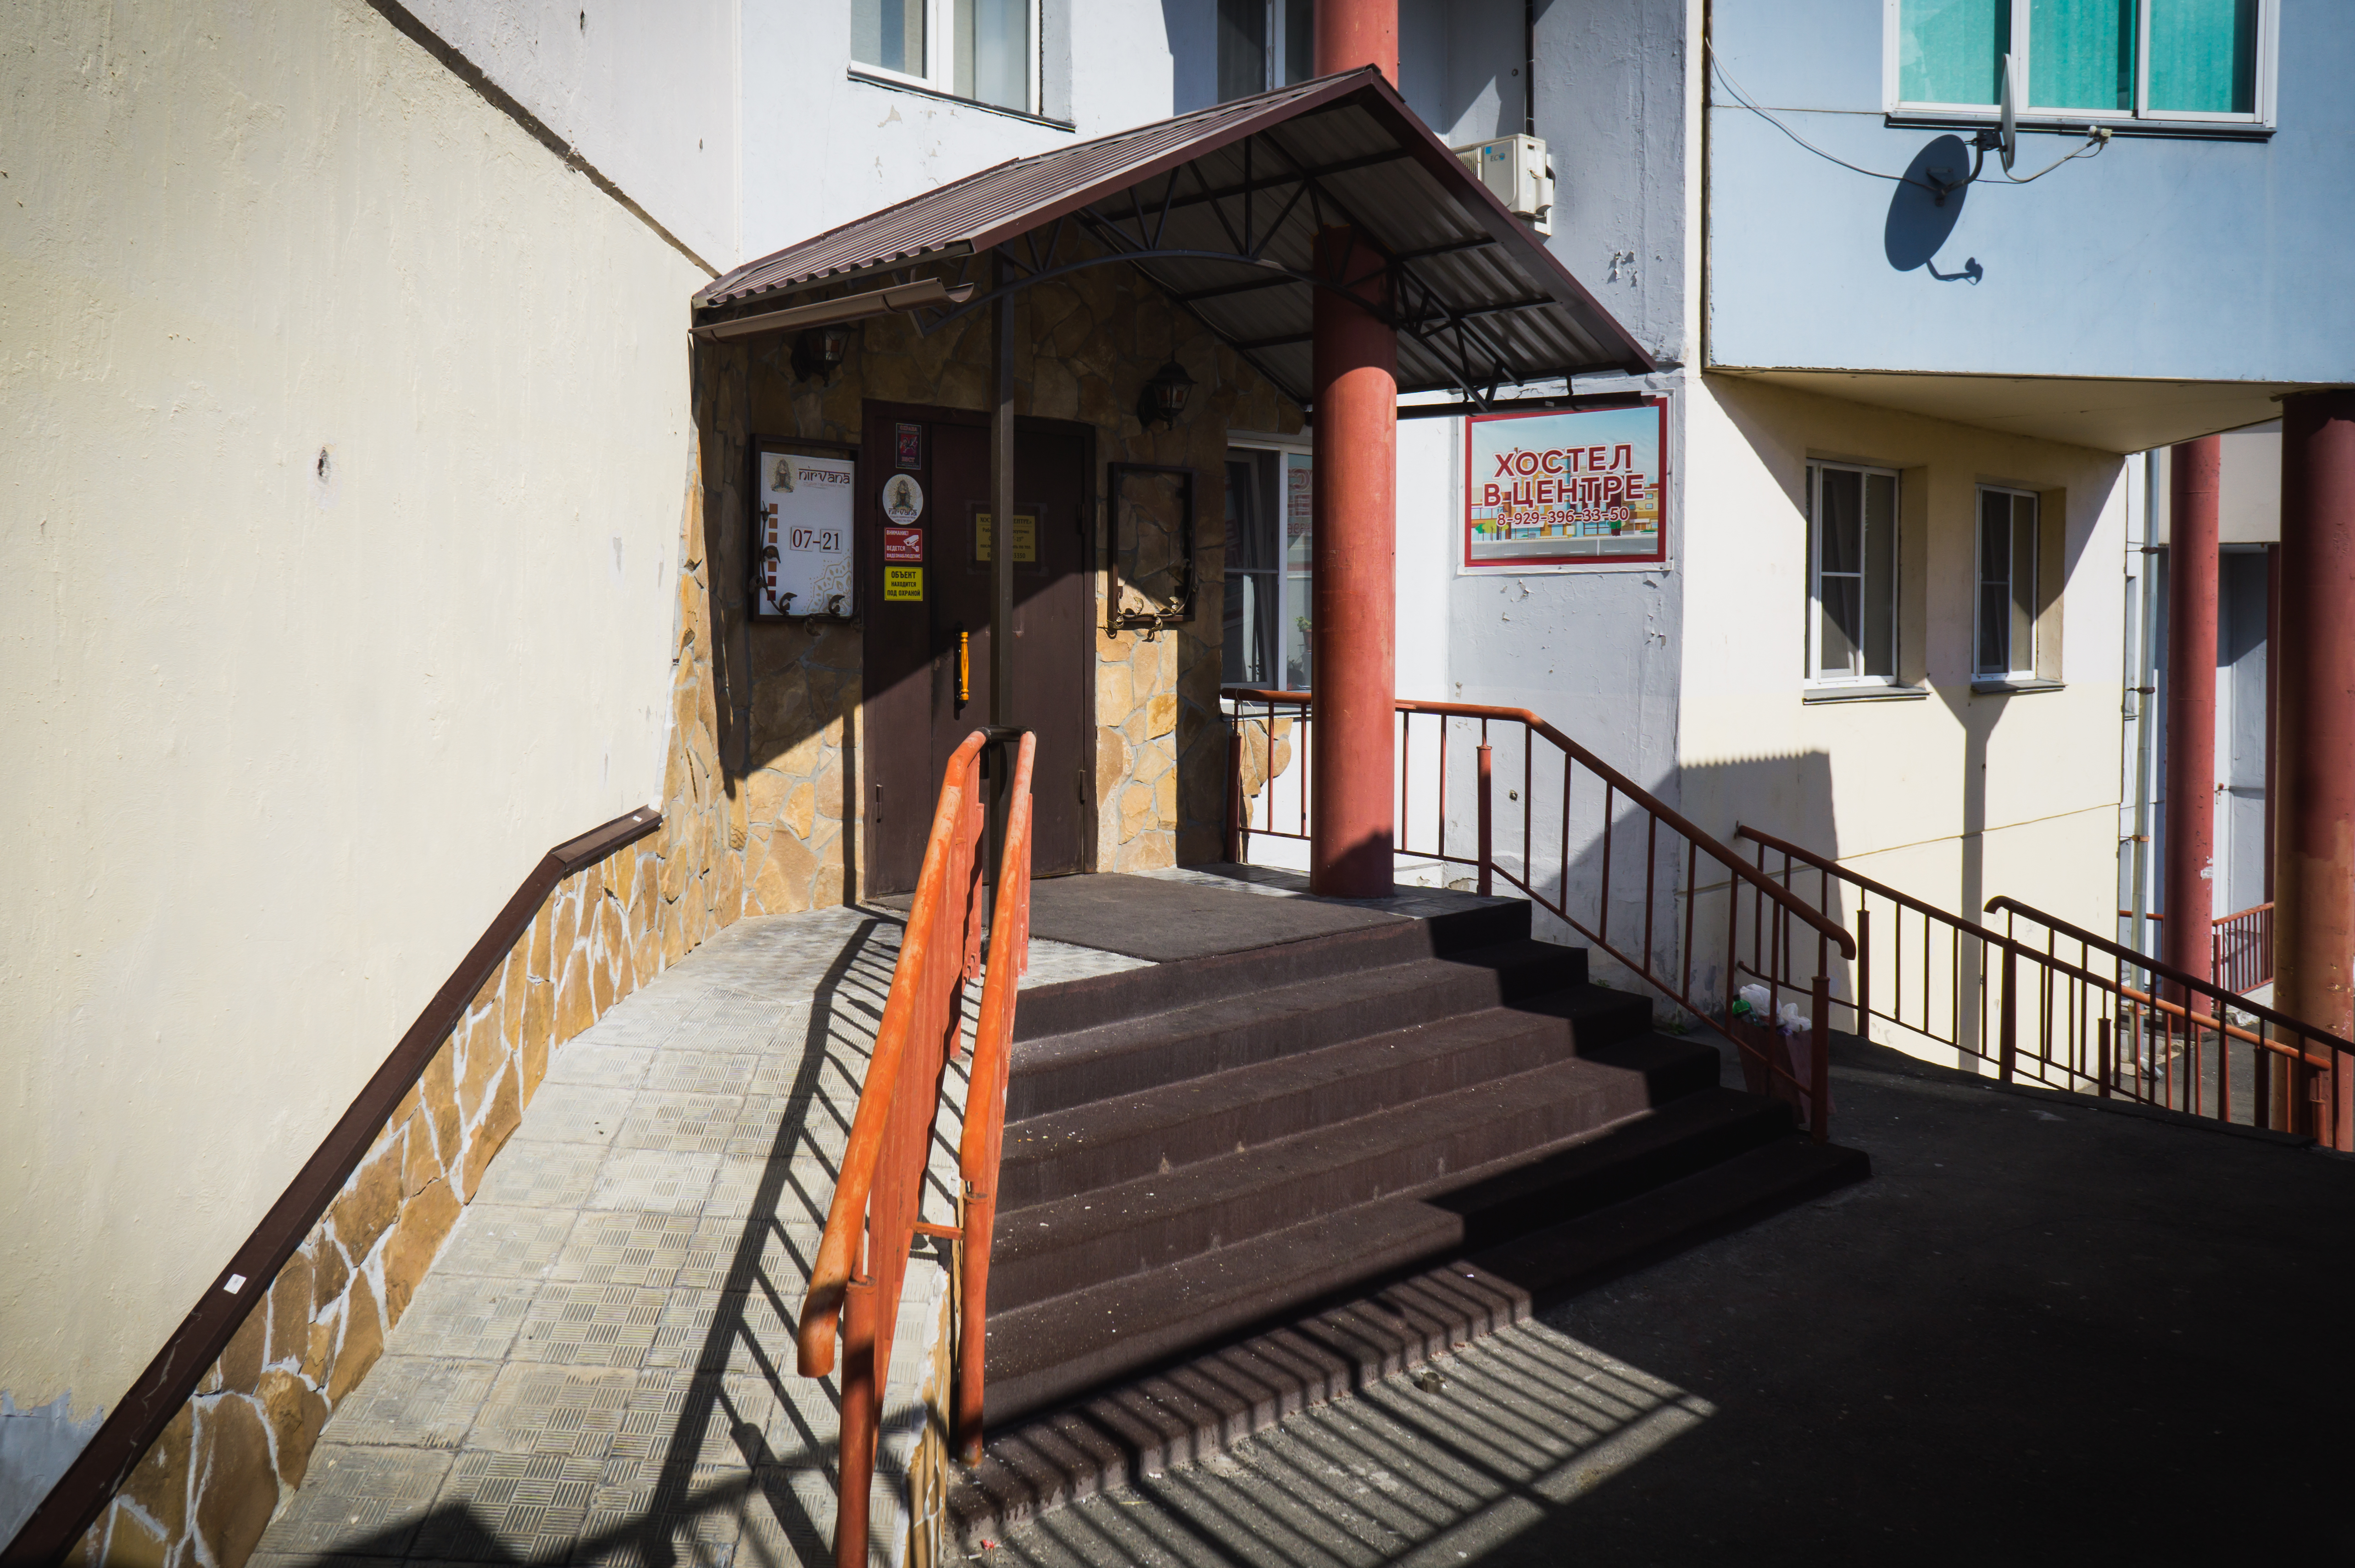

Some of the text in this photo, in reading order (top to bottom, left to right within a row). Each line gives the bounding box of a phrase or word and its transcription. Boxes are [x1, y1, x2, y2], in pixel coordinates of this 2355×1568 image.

[1493, 443, 1632, 478] ХОСТЕЛ
[798, 466, 850, 484] nirvana
[1483, 473, 1646, 509] В ЦЕНТРЕ
[1497, 507, 1630, 526] 8-929-396-33-50
